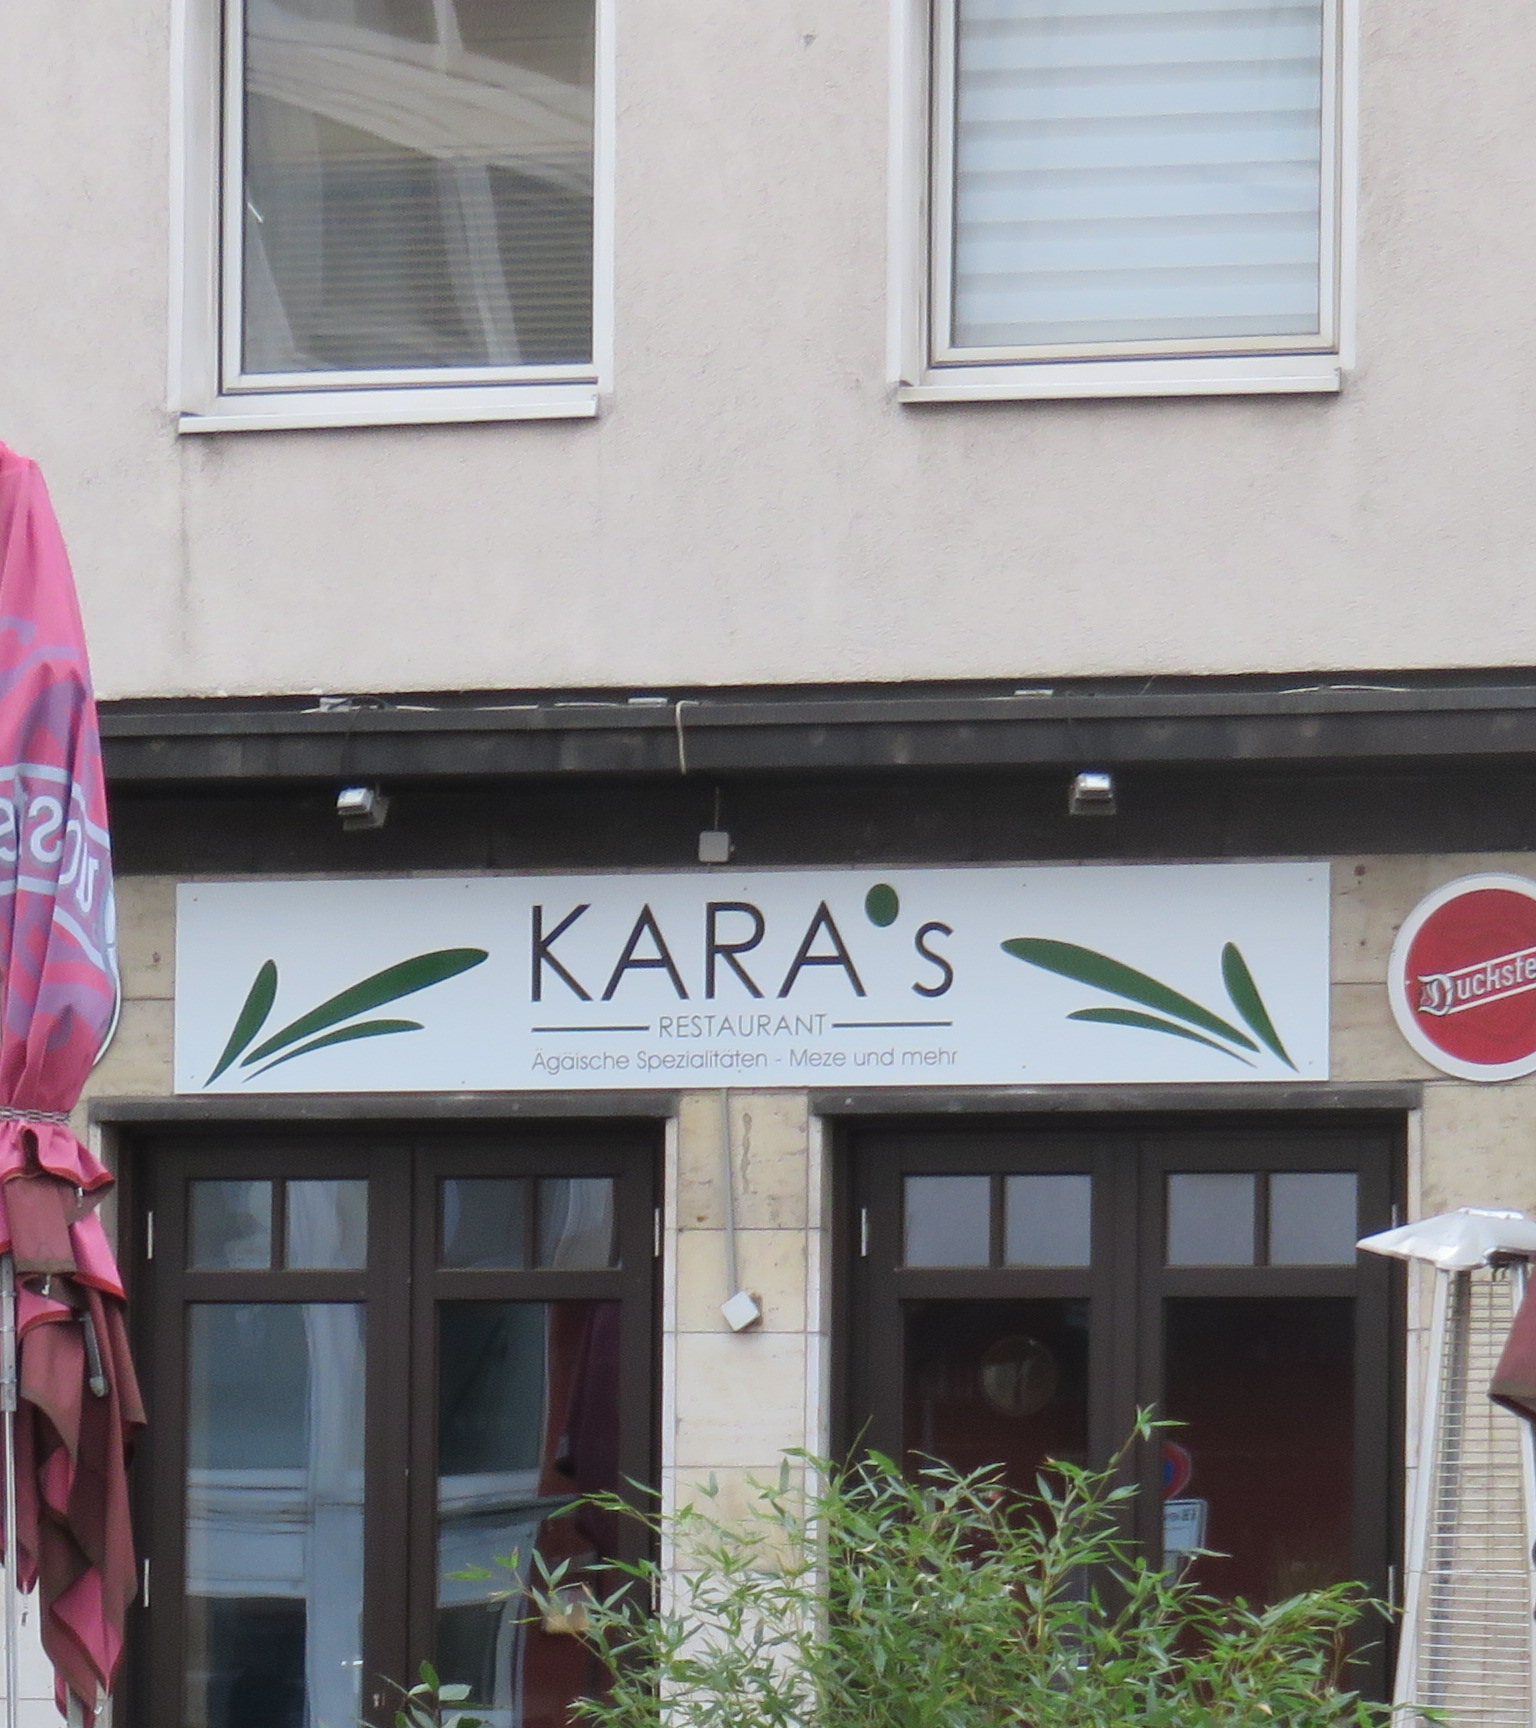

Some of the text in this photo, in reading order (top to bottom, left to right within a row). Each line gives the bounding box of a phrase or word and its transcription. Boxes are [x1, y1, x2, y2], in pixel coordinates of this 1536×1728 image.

[658, 1013, 828, 1039] RESTAURANT
[531, 1048, 630, 1076] Ägäische
[636, 1049, 768, 1074] Spezialitäten
[789, 1048, 847, 1068] Meze
[853, 1048, 895, 1067] und
[902, 1047, 958, 1066] mehr
